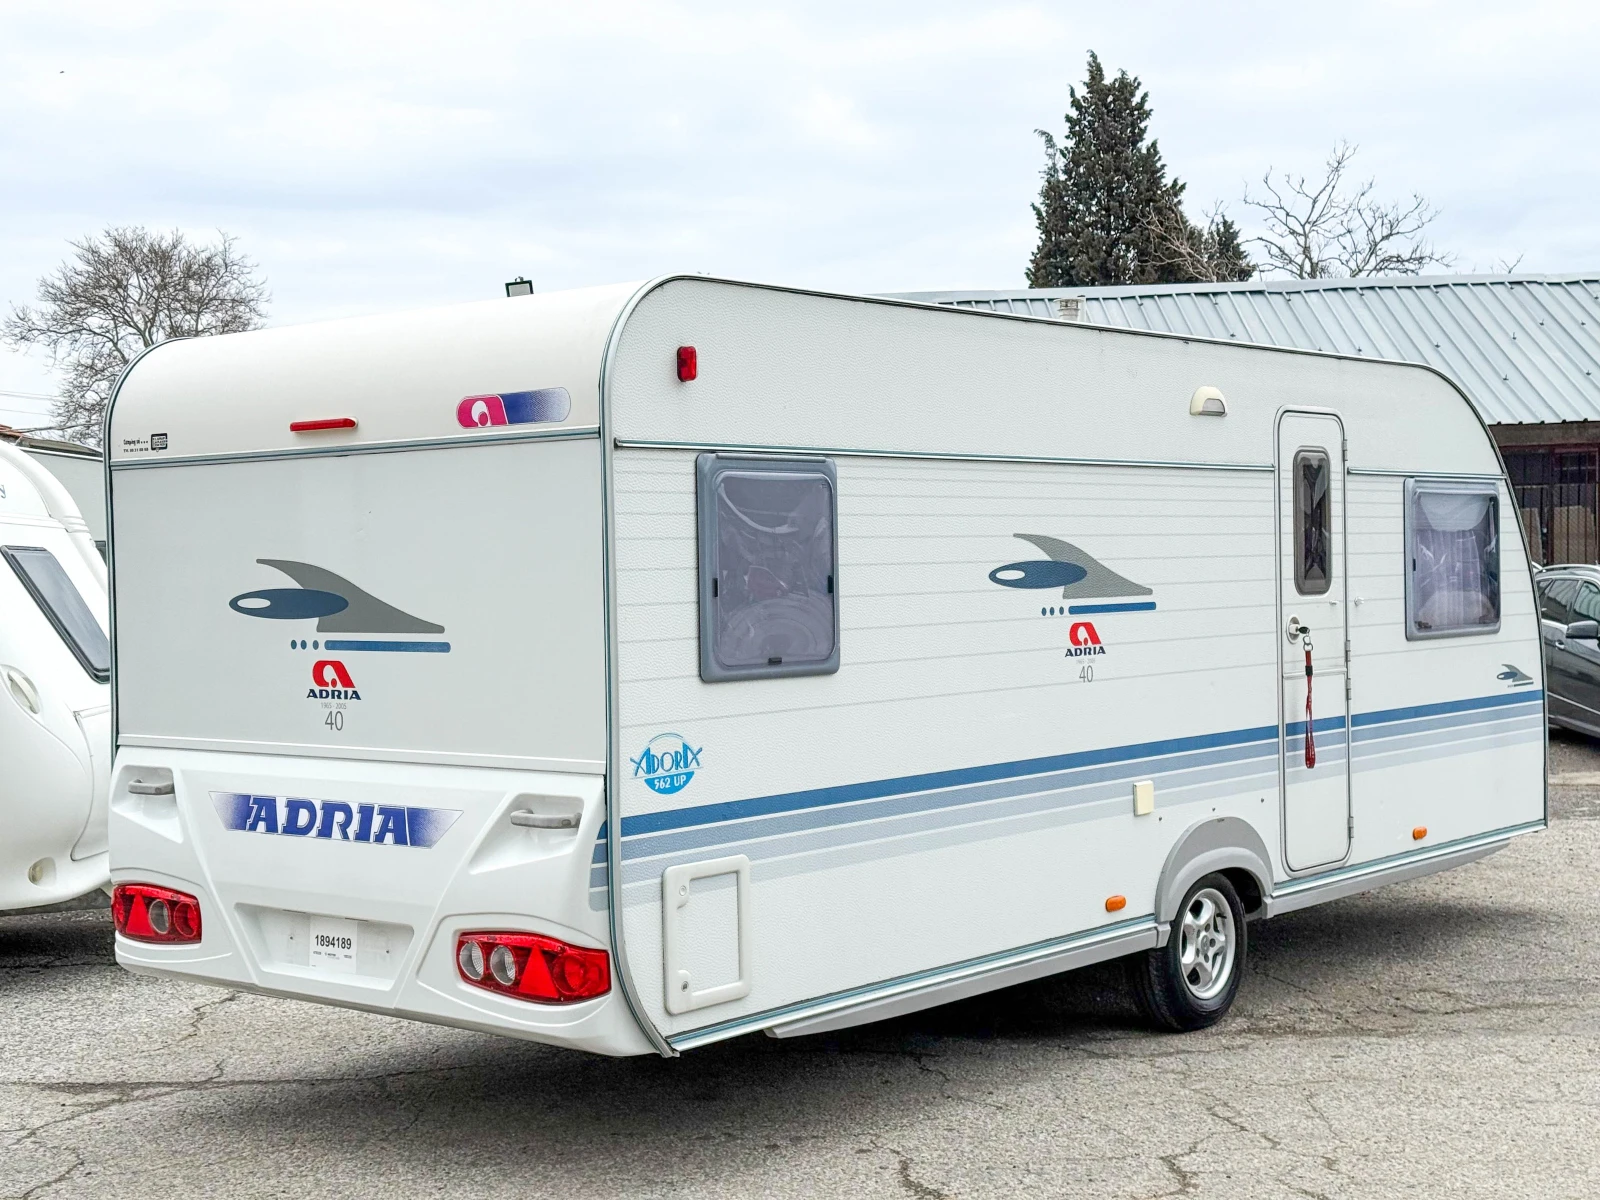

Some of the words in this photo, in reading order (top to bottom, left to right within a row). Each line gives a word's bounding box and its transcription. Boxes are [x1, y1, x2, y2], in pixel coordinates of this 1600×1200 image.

[1064, 646, 1106, 657] ADRIA
[1079, 665, 1094, 683] 40
[306, 688, 362, 700] ADRIA
[324, 710, 344, 731] 40
[654, 777, 671, 790] 562
[673, 774, 687, 787] UP
[245, 794, 412, 847] ADRIA
[315, 934, 352, 950] 1894189
